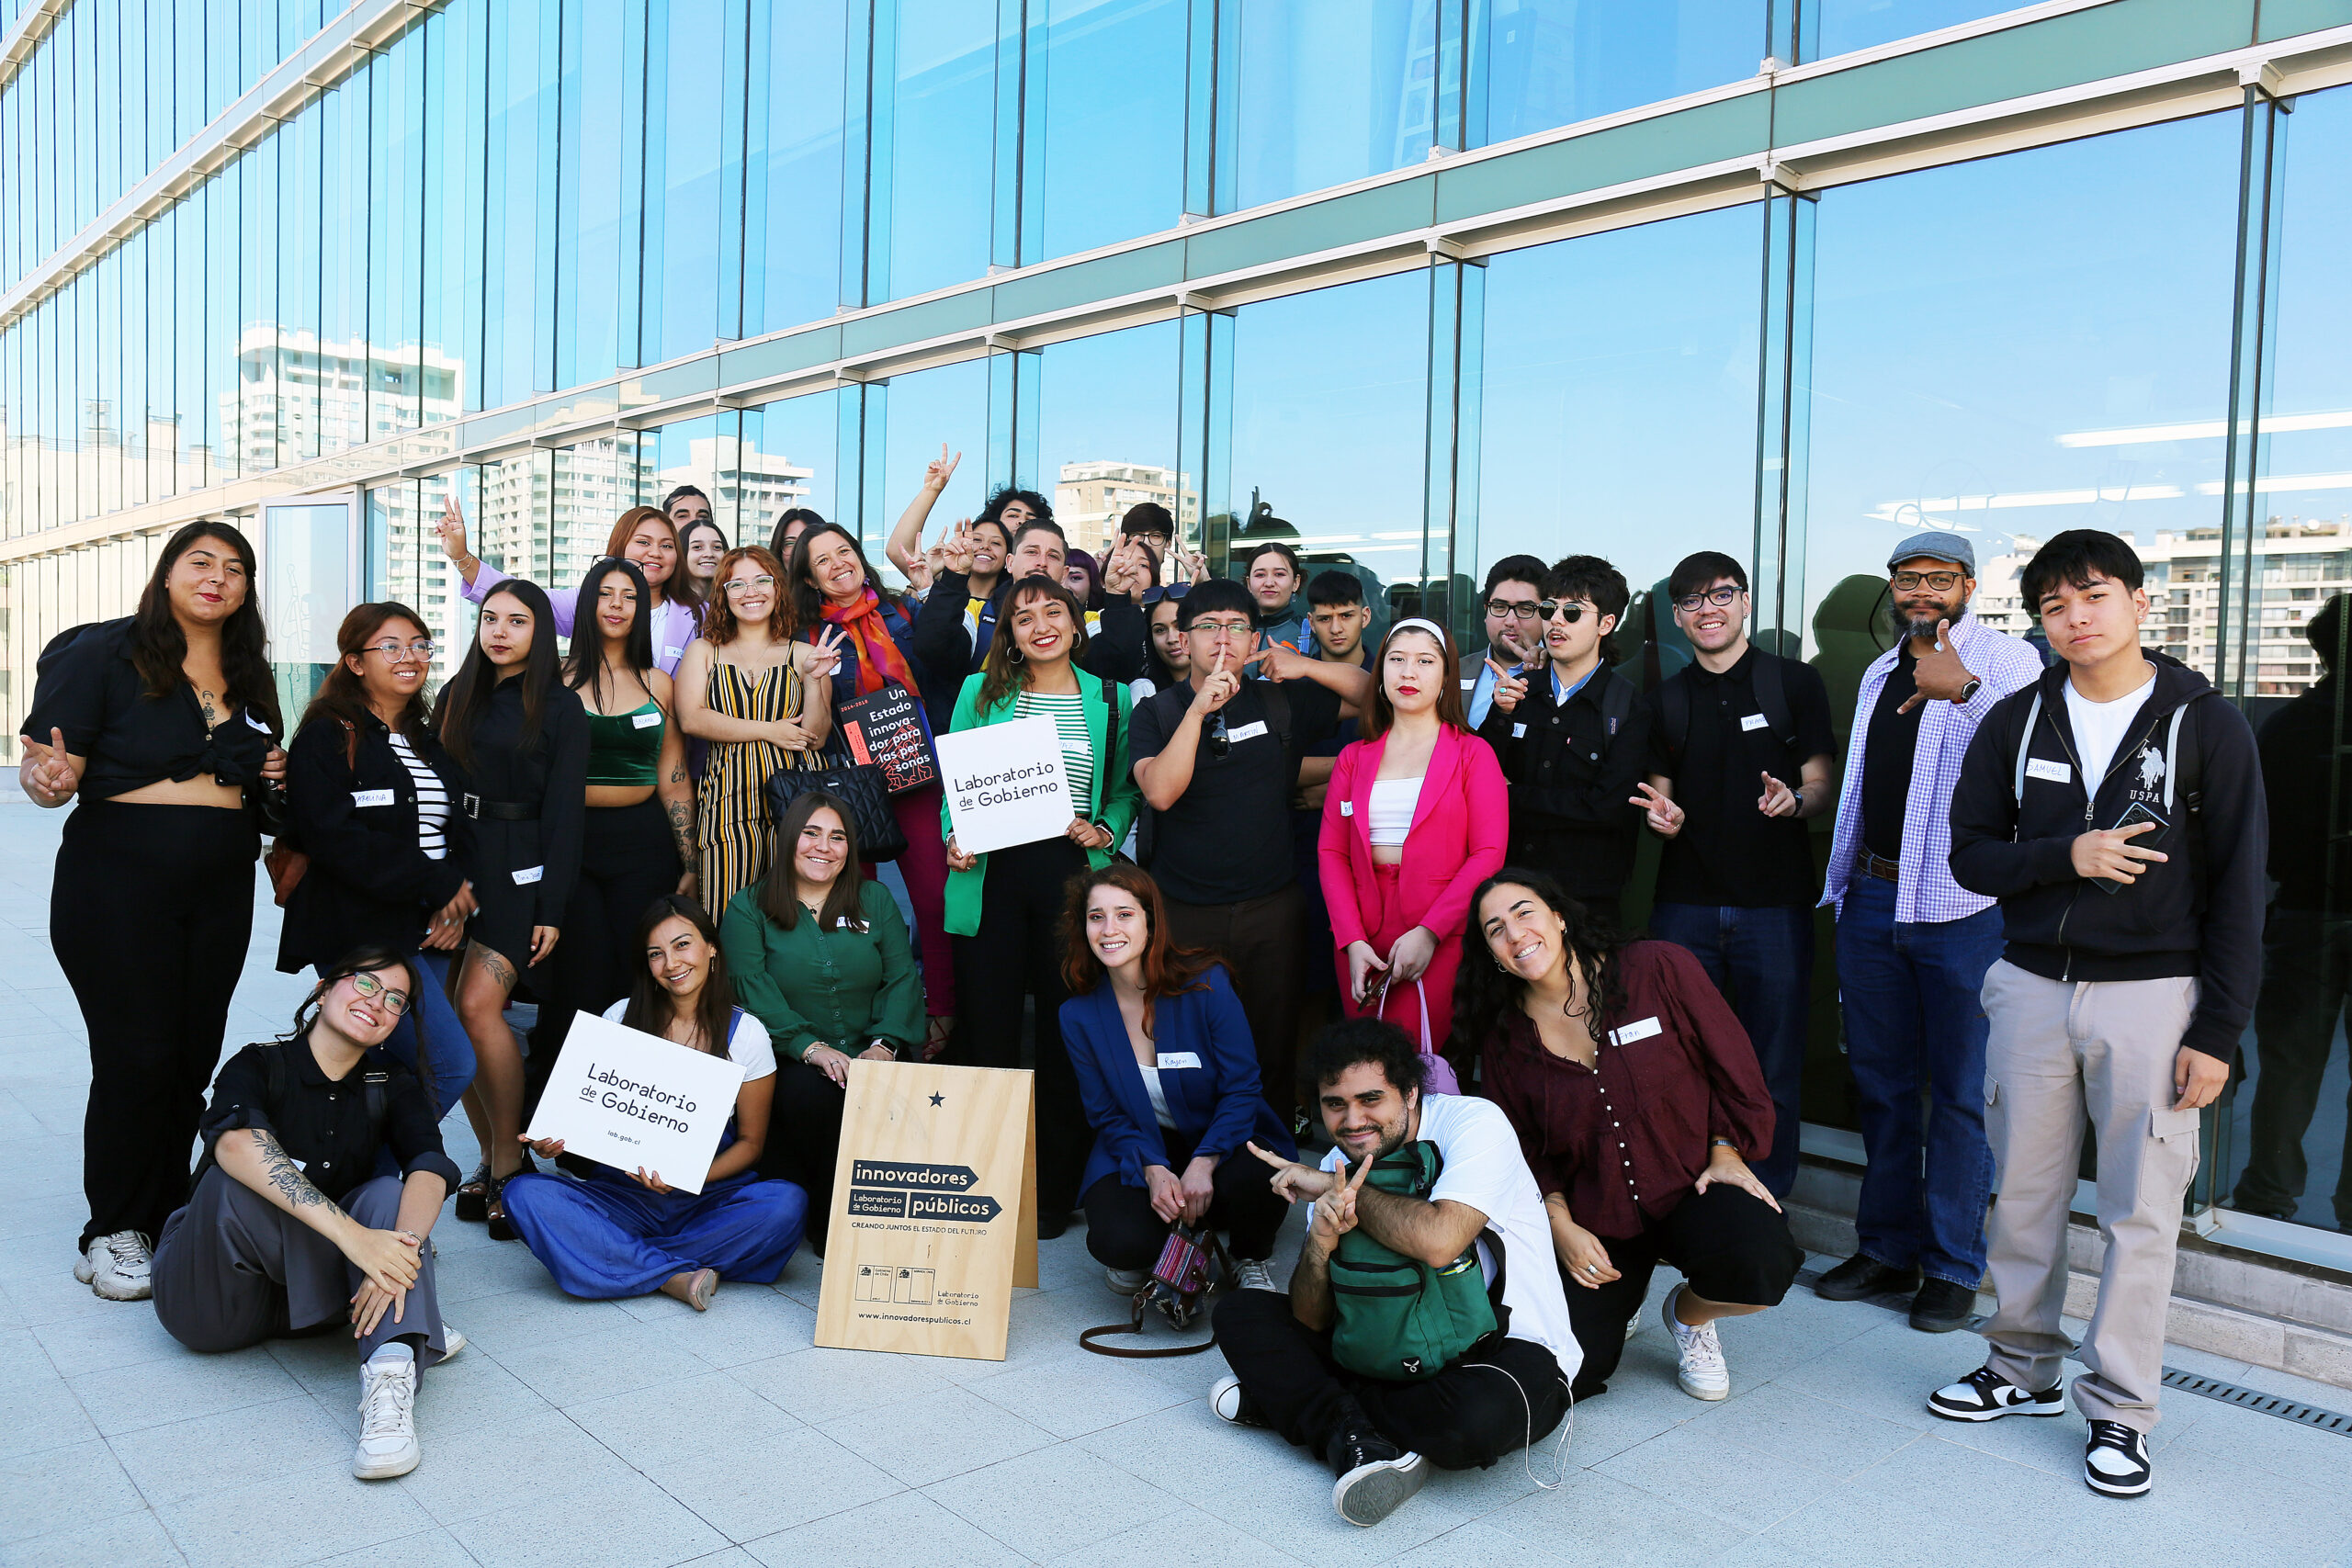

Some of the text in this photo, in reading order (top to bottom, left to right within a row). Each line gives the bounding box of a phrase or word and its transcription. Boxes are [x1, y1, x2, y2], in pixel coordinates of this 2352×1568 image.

[888, 689, 907, 700] Un
[869, 702, 911, 722] Estado
[868, 716, 915, 737] innova-
[869, 739, 888, 751] dor
[892, 728, 921, 747] para
[878, 743, 925, 762] las per-
[896, 754, 931, 772] sonas
[955, 762, 1054, 792] Laboratorio
[959, 783, 1057, 807] de Gobierno
[2130, 790, 2160, 803] USPA
[588, 1063, 696, 1112] Laboratorio
[581, 1085, 689, 1133] de Gobierno
[608, 1130, 640, 1145] lab.gob.cl
[856, 1164, 967, 1186] innovadores
[854, 1194, 902, 1203] Laboratorio
[862, 1203, 901, 1213] Gobierno
[912, 1197, 989, 1216] públicos
[938, 1291, 978, 1299] Laboratorio
[858, 1313, 971, 1325] www.innovadorespublicos.cl
